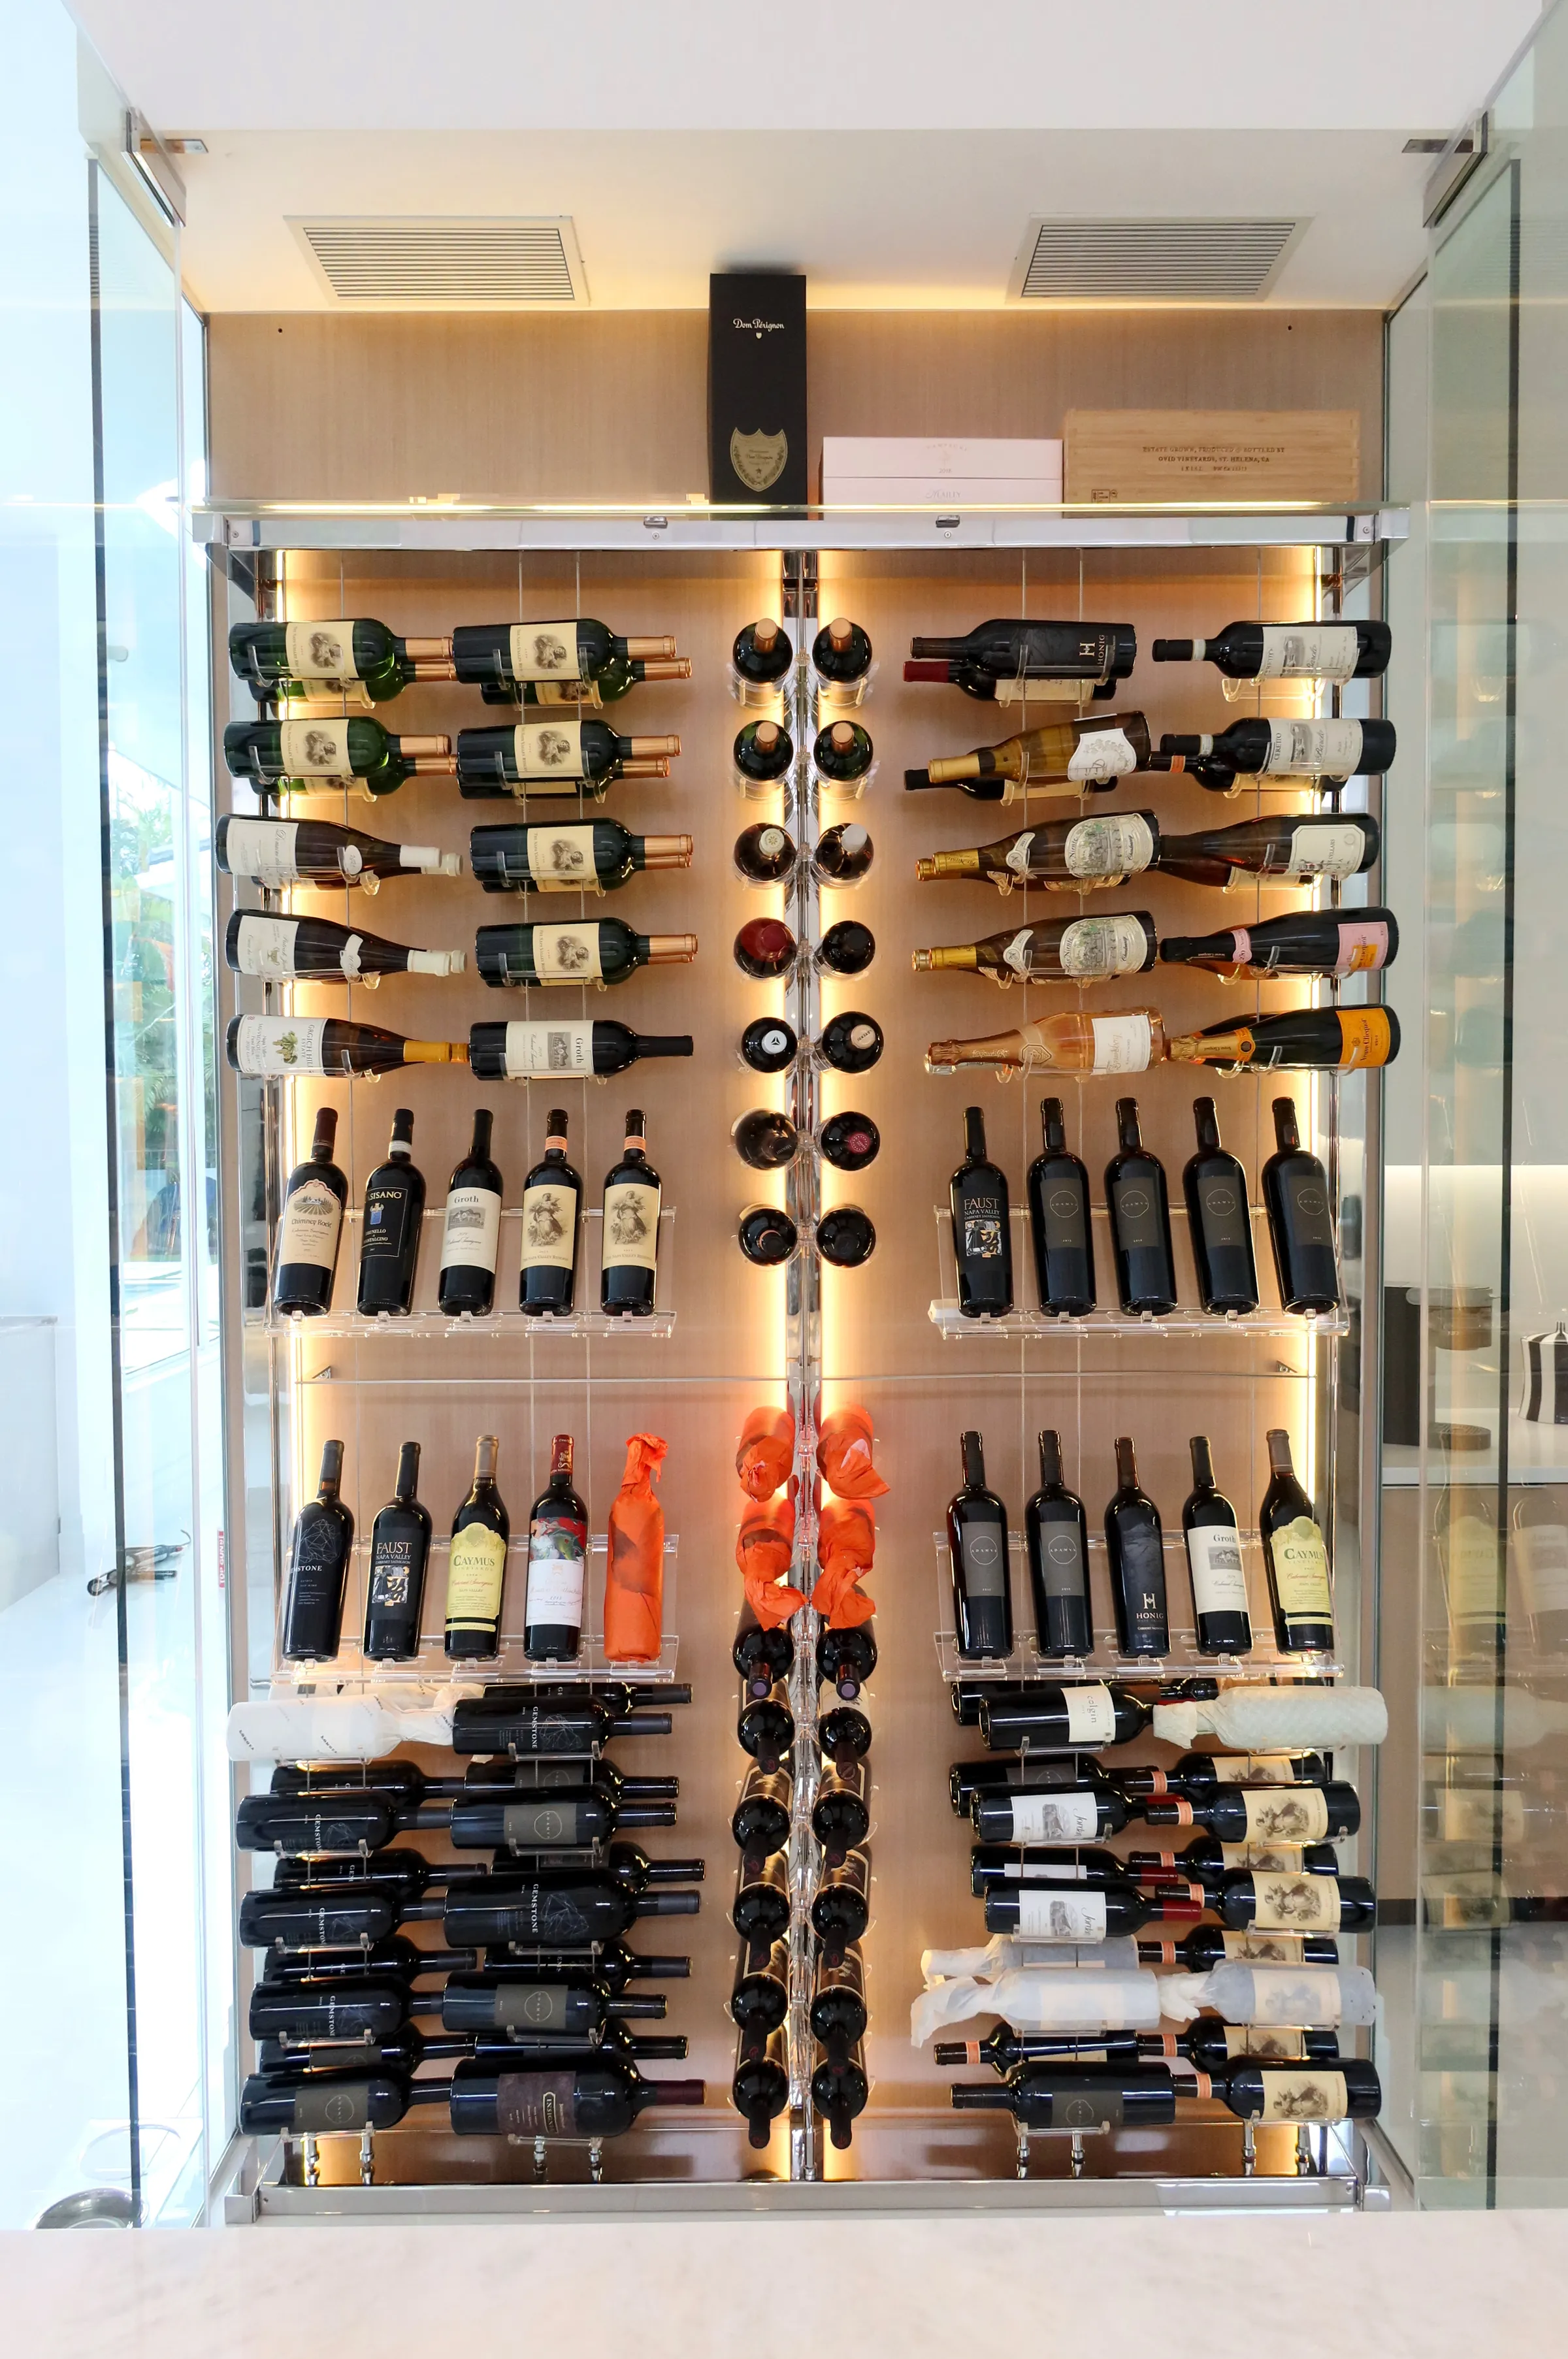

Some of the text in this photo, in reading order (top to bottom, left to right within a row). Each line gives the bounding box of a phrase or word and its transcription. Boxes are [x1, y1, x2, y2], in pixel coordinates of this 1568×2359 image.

[732, 318, 785, 332] Dom Pérignon
[1096, 634, 1105, 665] HONIG
[1273, 732, 1282, 761] CERETTO
[1315, 728, 1325, 764] Barolo
[1069, 838, 1079, 858] Niente
[1063, 936, 1073, 957] Niente
[305, 1024, 315, 1053] GRGICH
[1360, 1018, 1371, 1061] Veuve Clicquot
[575, 1037, 584, 1064] Groth
[453, 1194, 479, 1204] Groth
[964, 1197, 1000, 1210] FAUST
[291, 1218, 316, 1227] Chimney
[376, 1542, 412, 1554] FAUST
[1213, 1534, 1236, 1544] Groth
[453, 1555, 495, 1567] CAYMUS
[1284, 1548, 1324, 1560] CAYMUS
[291, 1565, 323, 1574] EMSTONE
[1086, 1695, 1099, 1723] colgin
[531, 1883, 540, 1933] GEMSTONE
